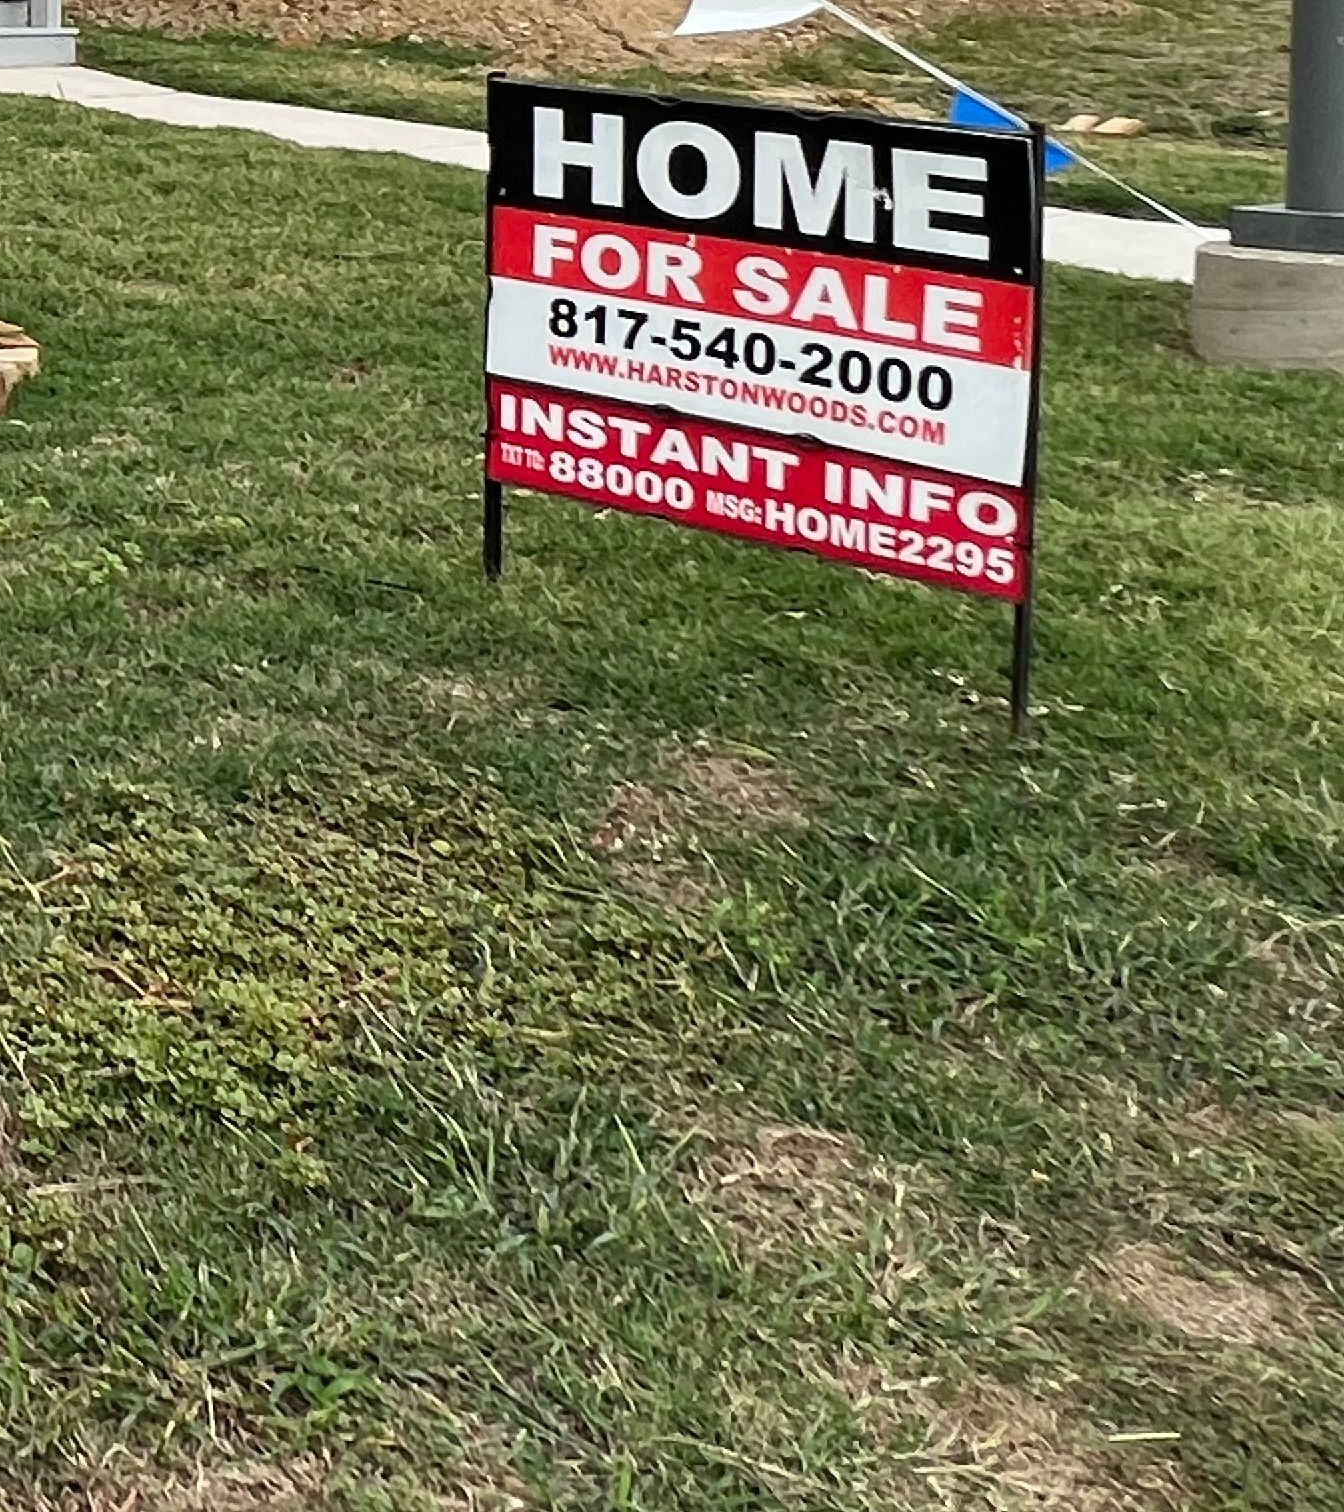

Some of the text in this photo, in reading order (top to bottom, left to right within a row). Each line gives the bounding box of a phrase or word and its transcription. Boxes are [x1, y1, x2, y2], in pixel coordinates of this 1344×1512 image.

[532, 106, 991, 261] HOME
[532, 224, 984, 353] FOR SALE
[548, 298, 954, 411] 817-540-2000
[548, 343, 947, 446] WWW.HARSTONWOODS.COM
[500, 393, 1018, 537] INSTANT INFO
[548, 450, 695, 510] 88000
[705, 489, 762, 525] MSG:
[764, 498, 1015, 584] HOME2295
